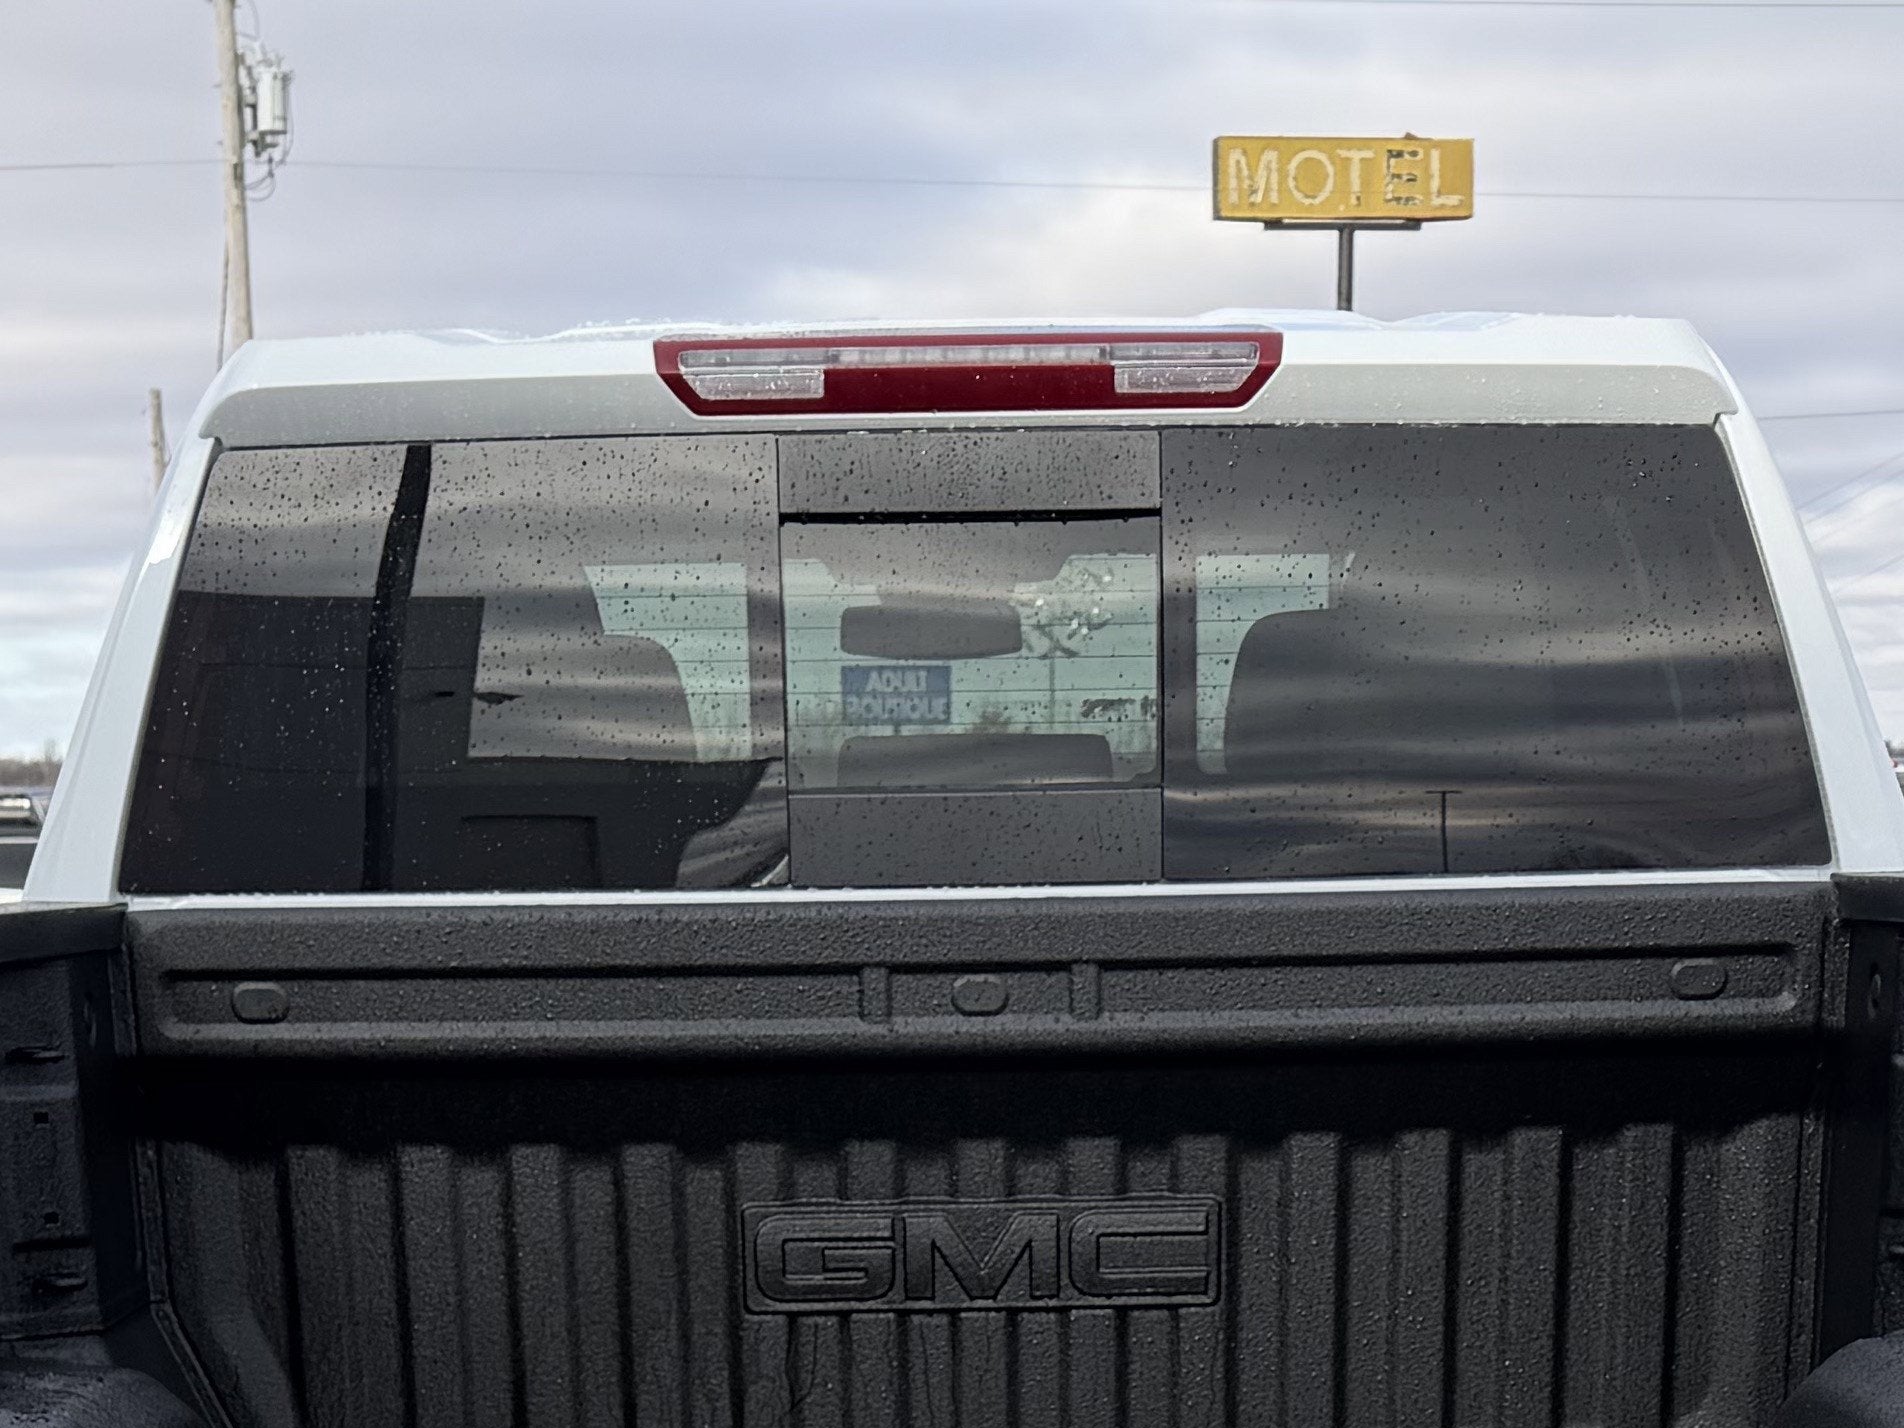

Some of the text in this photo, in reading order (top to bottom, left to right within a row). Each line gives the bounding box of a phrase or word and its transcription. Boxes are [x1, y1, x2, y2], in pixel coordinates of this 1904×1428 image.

[1227, 149, 1465, 207] MOTEL
[865, 669, 927, 693] ADULT
[755, 1209, 1209, 1301] GMC
